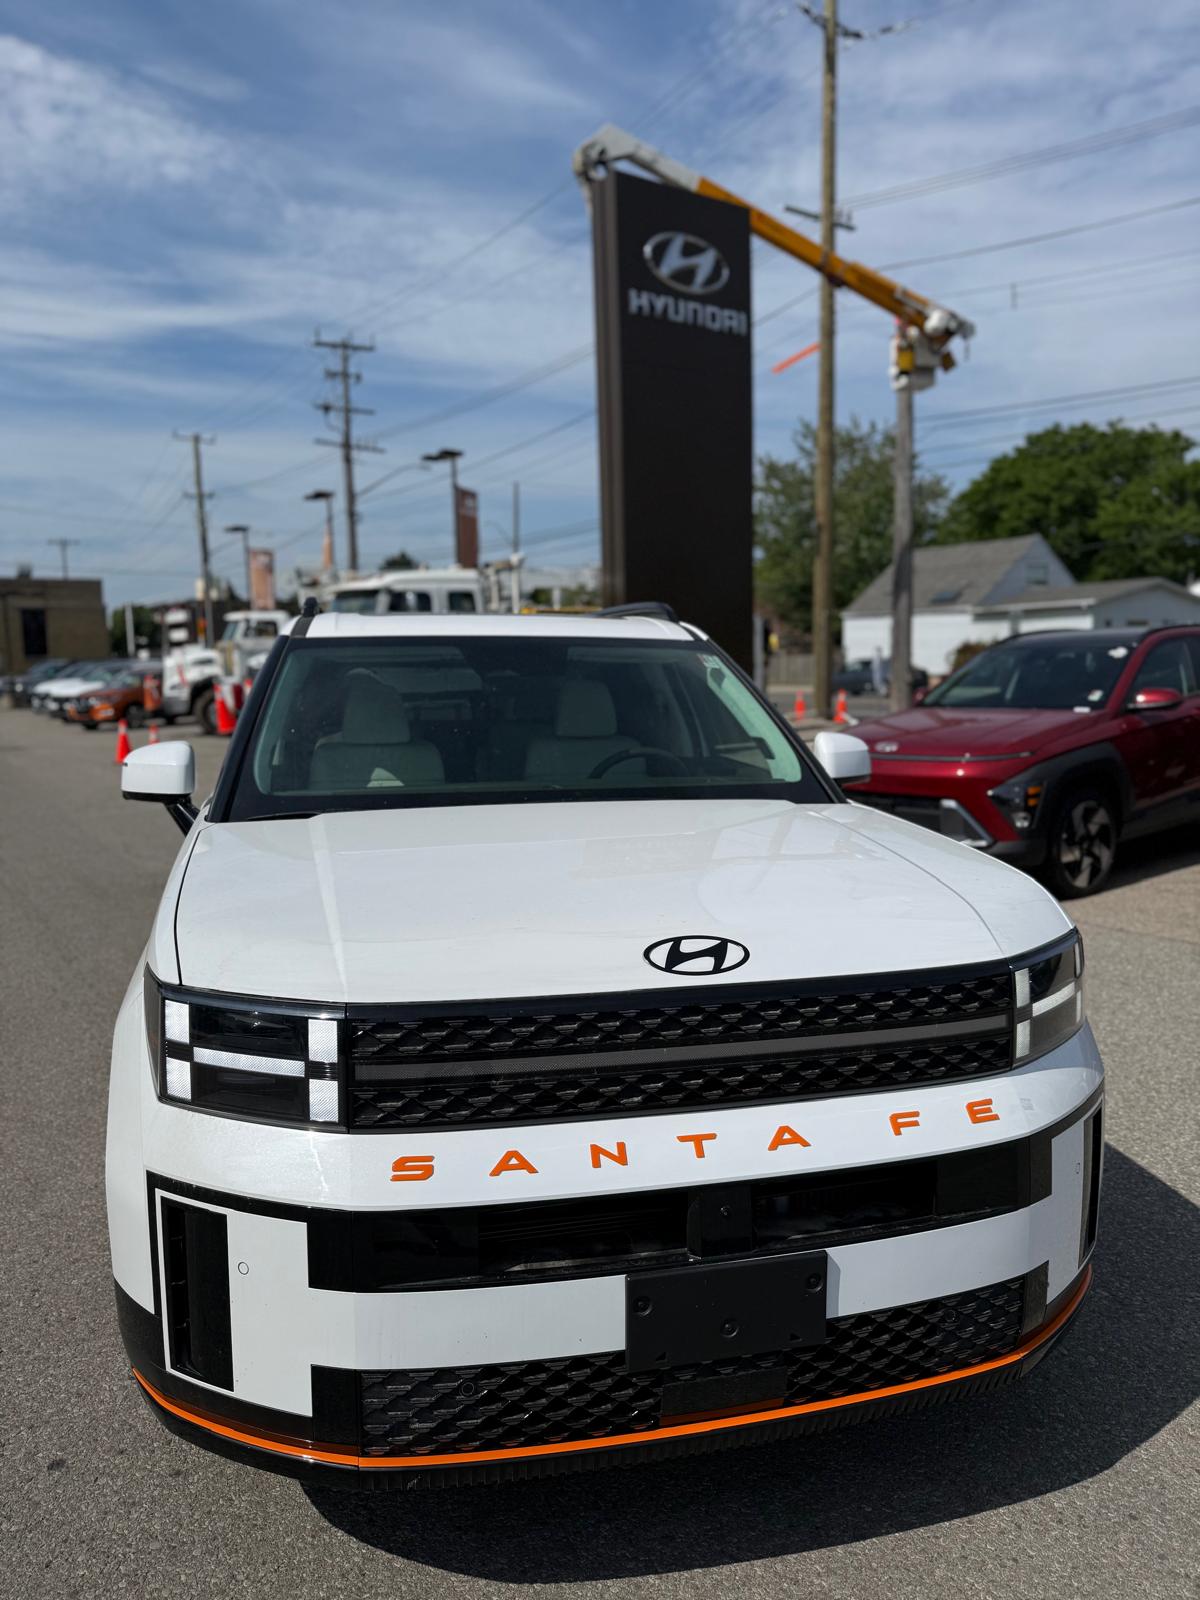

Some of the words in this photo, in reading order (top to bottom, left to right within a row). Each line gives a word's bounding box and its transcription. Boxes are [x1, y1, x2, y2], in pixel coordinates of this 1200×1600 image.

[628, 287, 748, 336] HYUNDAI
[390, 1125, 812, 1182] SANTA
[888, 1098, 1001, 1136] FE
